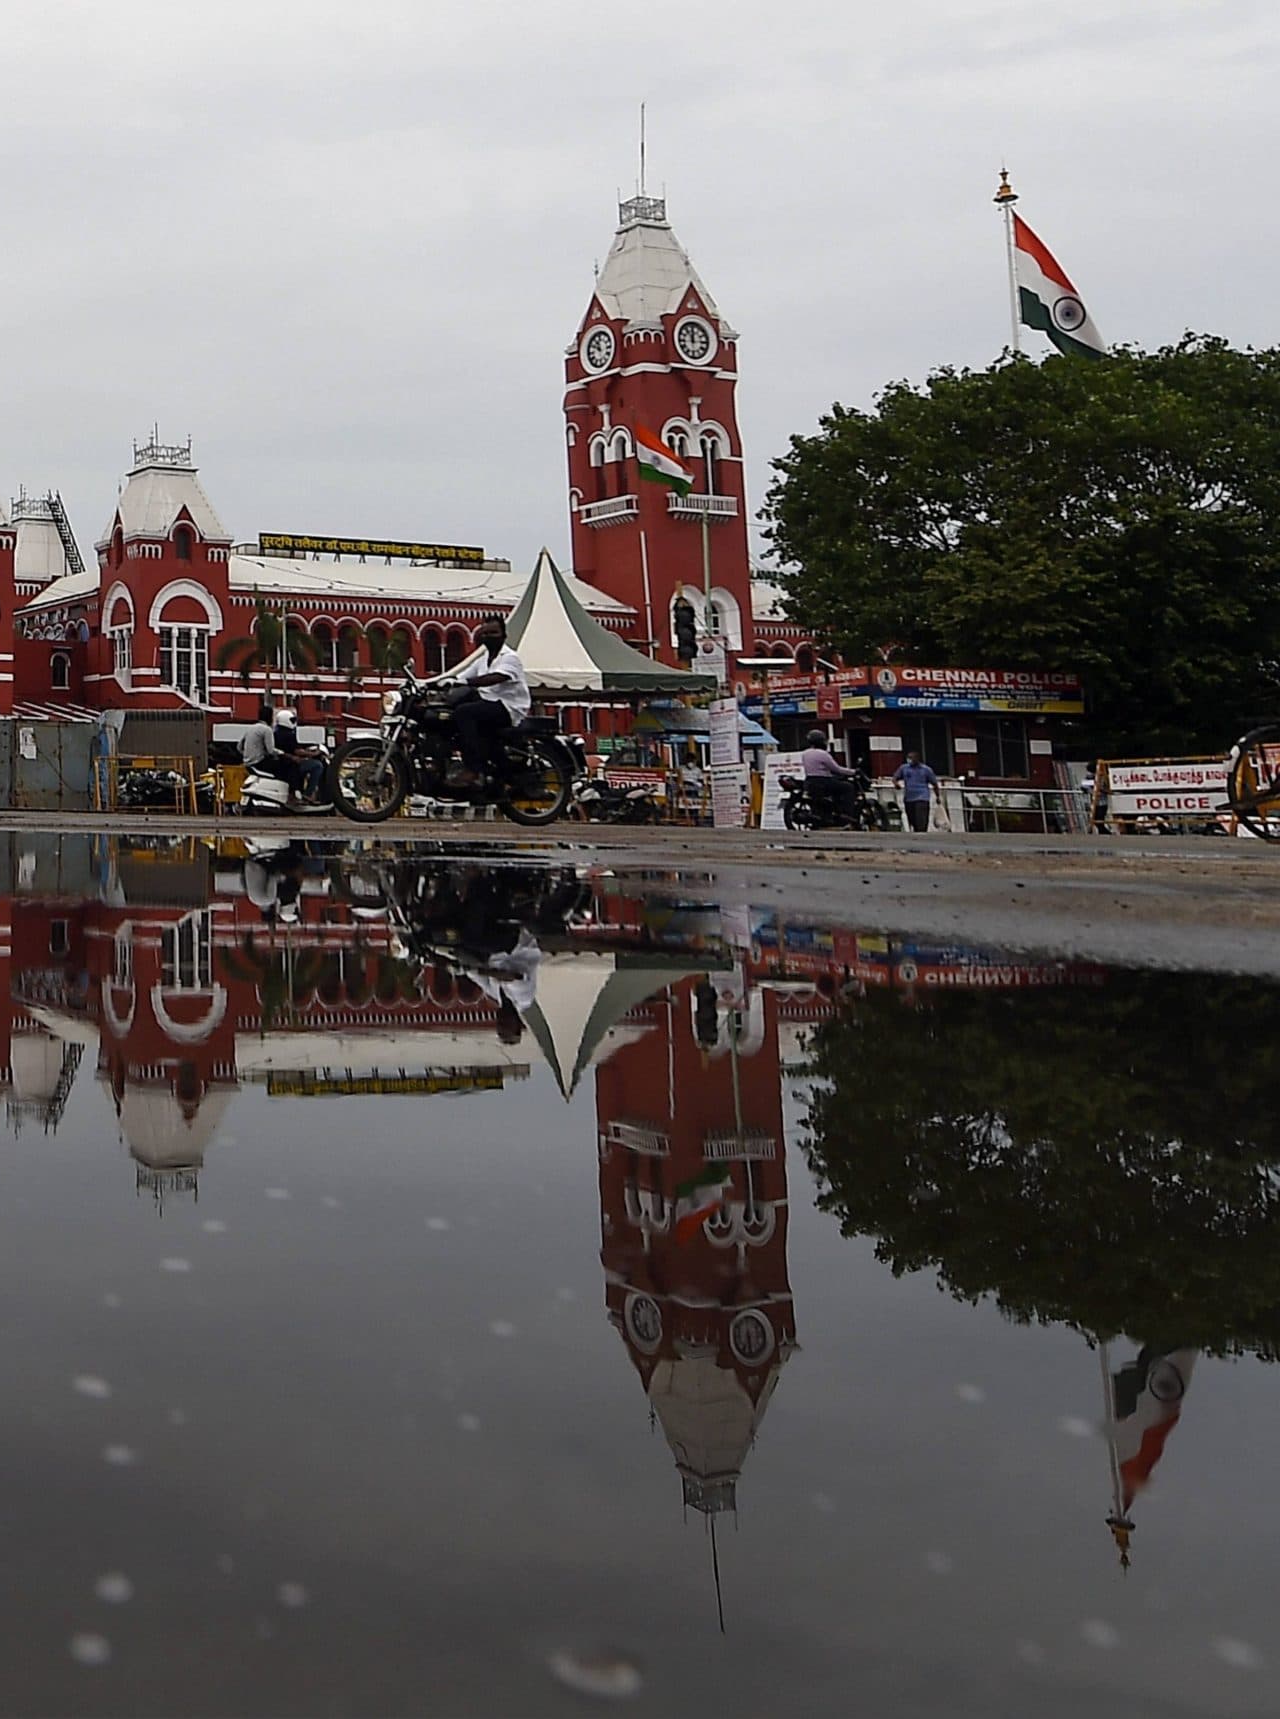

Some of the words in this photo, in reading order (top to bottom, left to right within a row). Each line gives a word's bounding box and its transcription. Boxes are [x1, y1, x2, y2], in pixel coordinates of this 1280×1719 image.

[901, 669, 996, 683] CHENNAI
[1003, 672, 1077, 685] POLICE
[898, 697, 940, 708] ORBIT
[1136, 797, 1211, 810] POLICE
